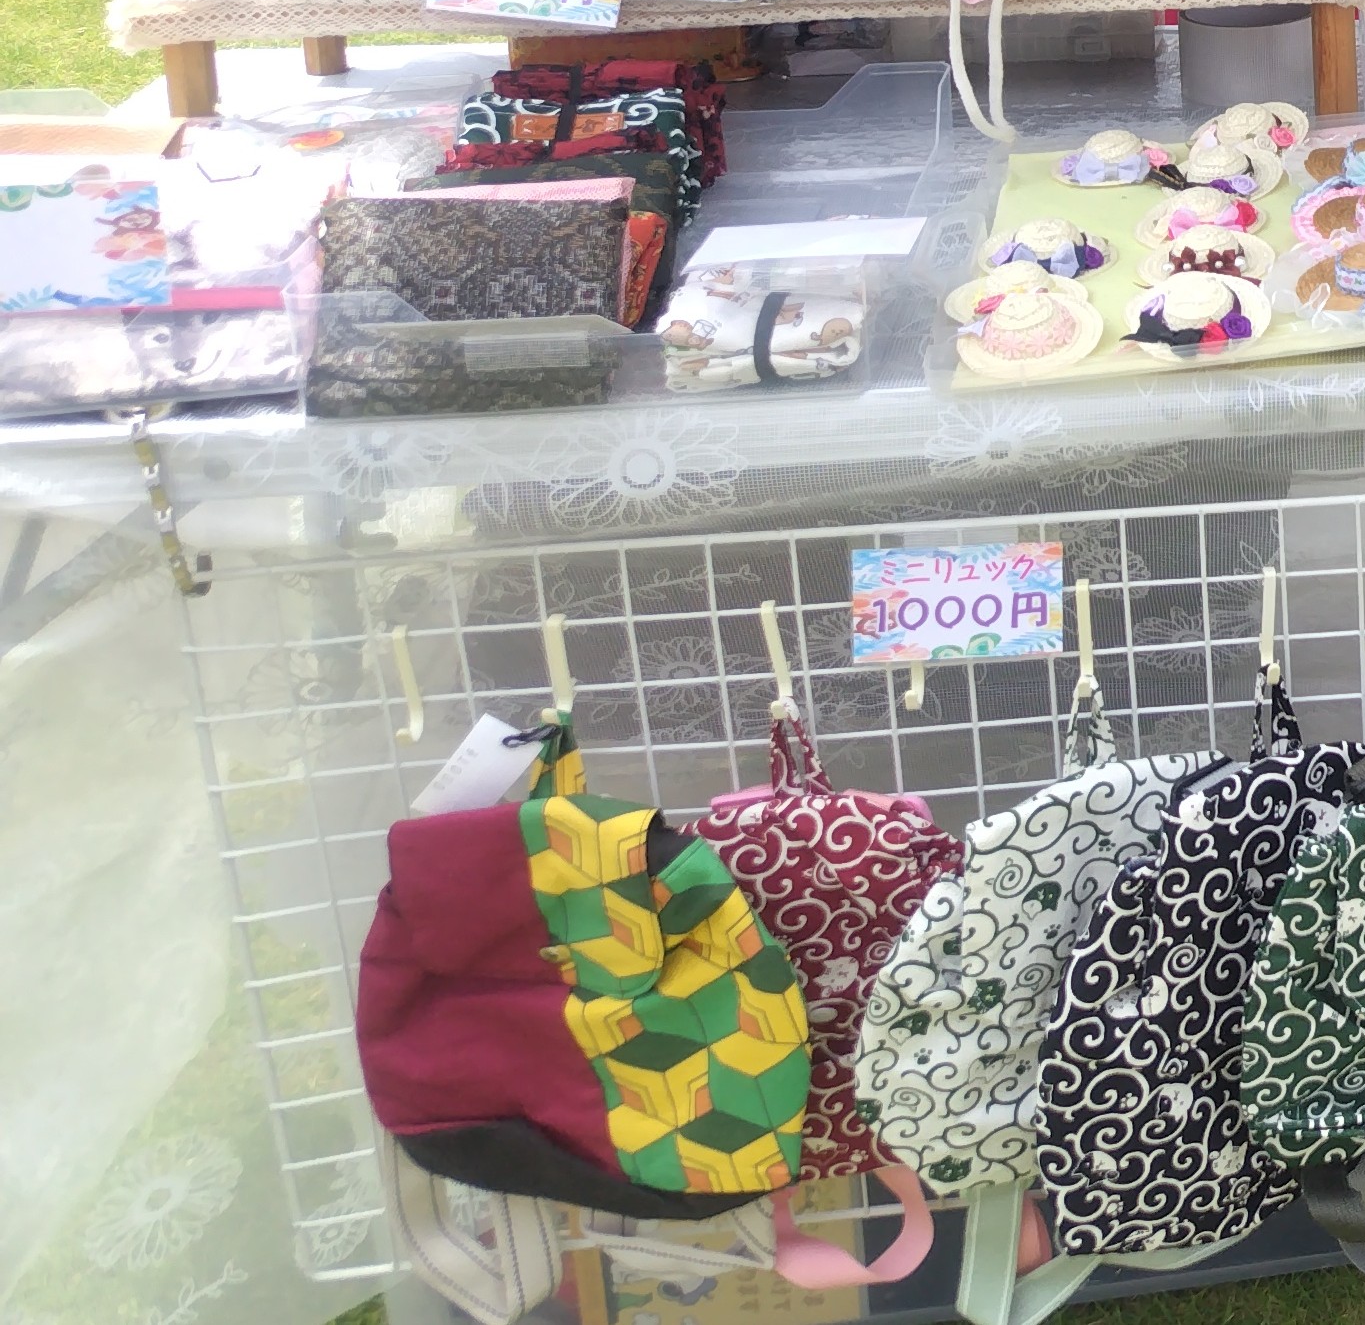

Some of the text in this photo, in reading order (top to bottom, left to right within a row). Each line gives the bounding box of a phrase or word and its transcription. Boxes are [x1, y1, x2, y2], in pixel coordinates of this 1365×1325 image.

[881, 554, 1034, 585] ミニリュック
[873, 592, 1047, 632] 1000円
